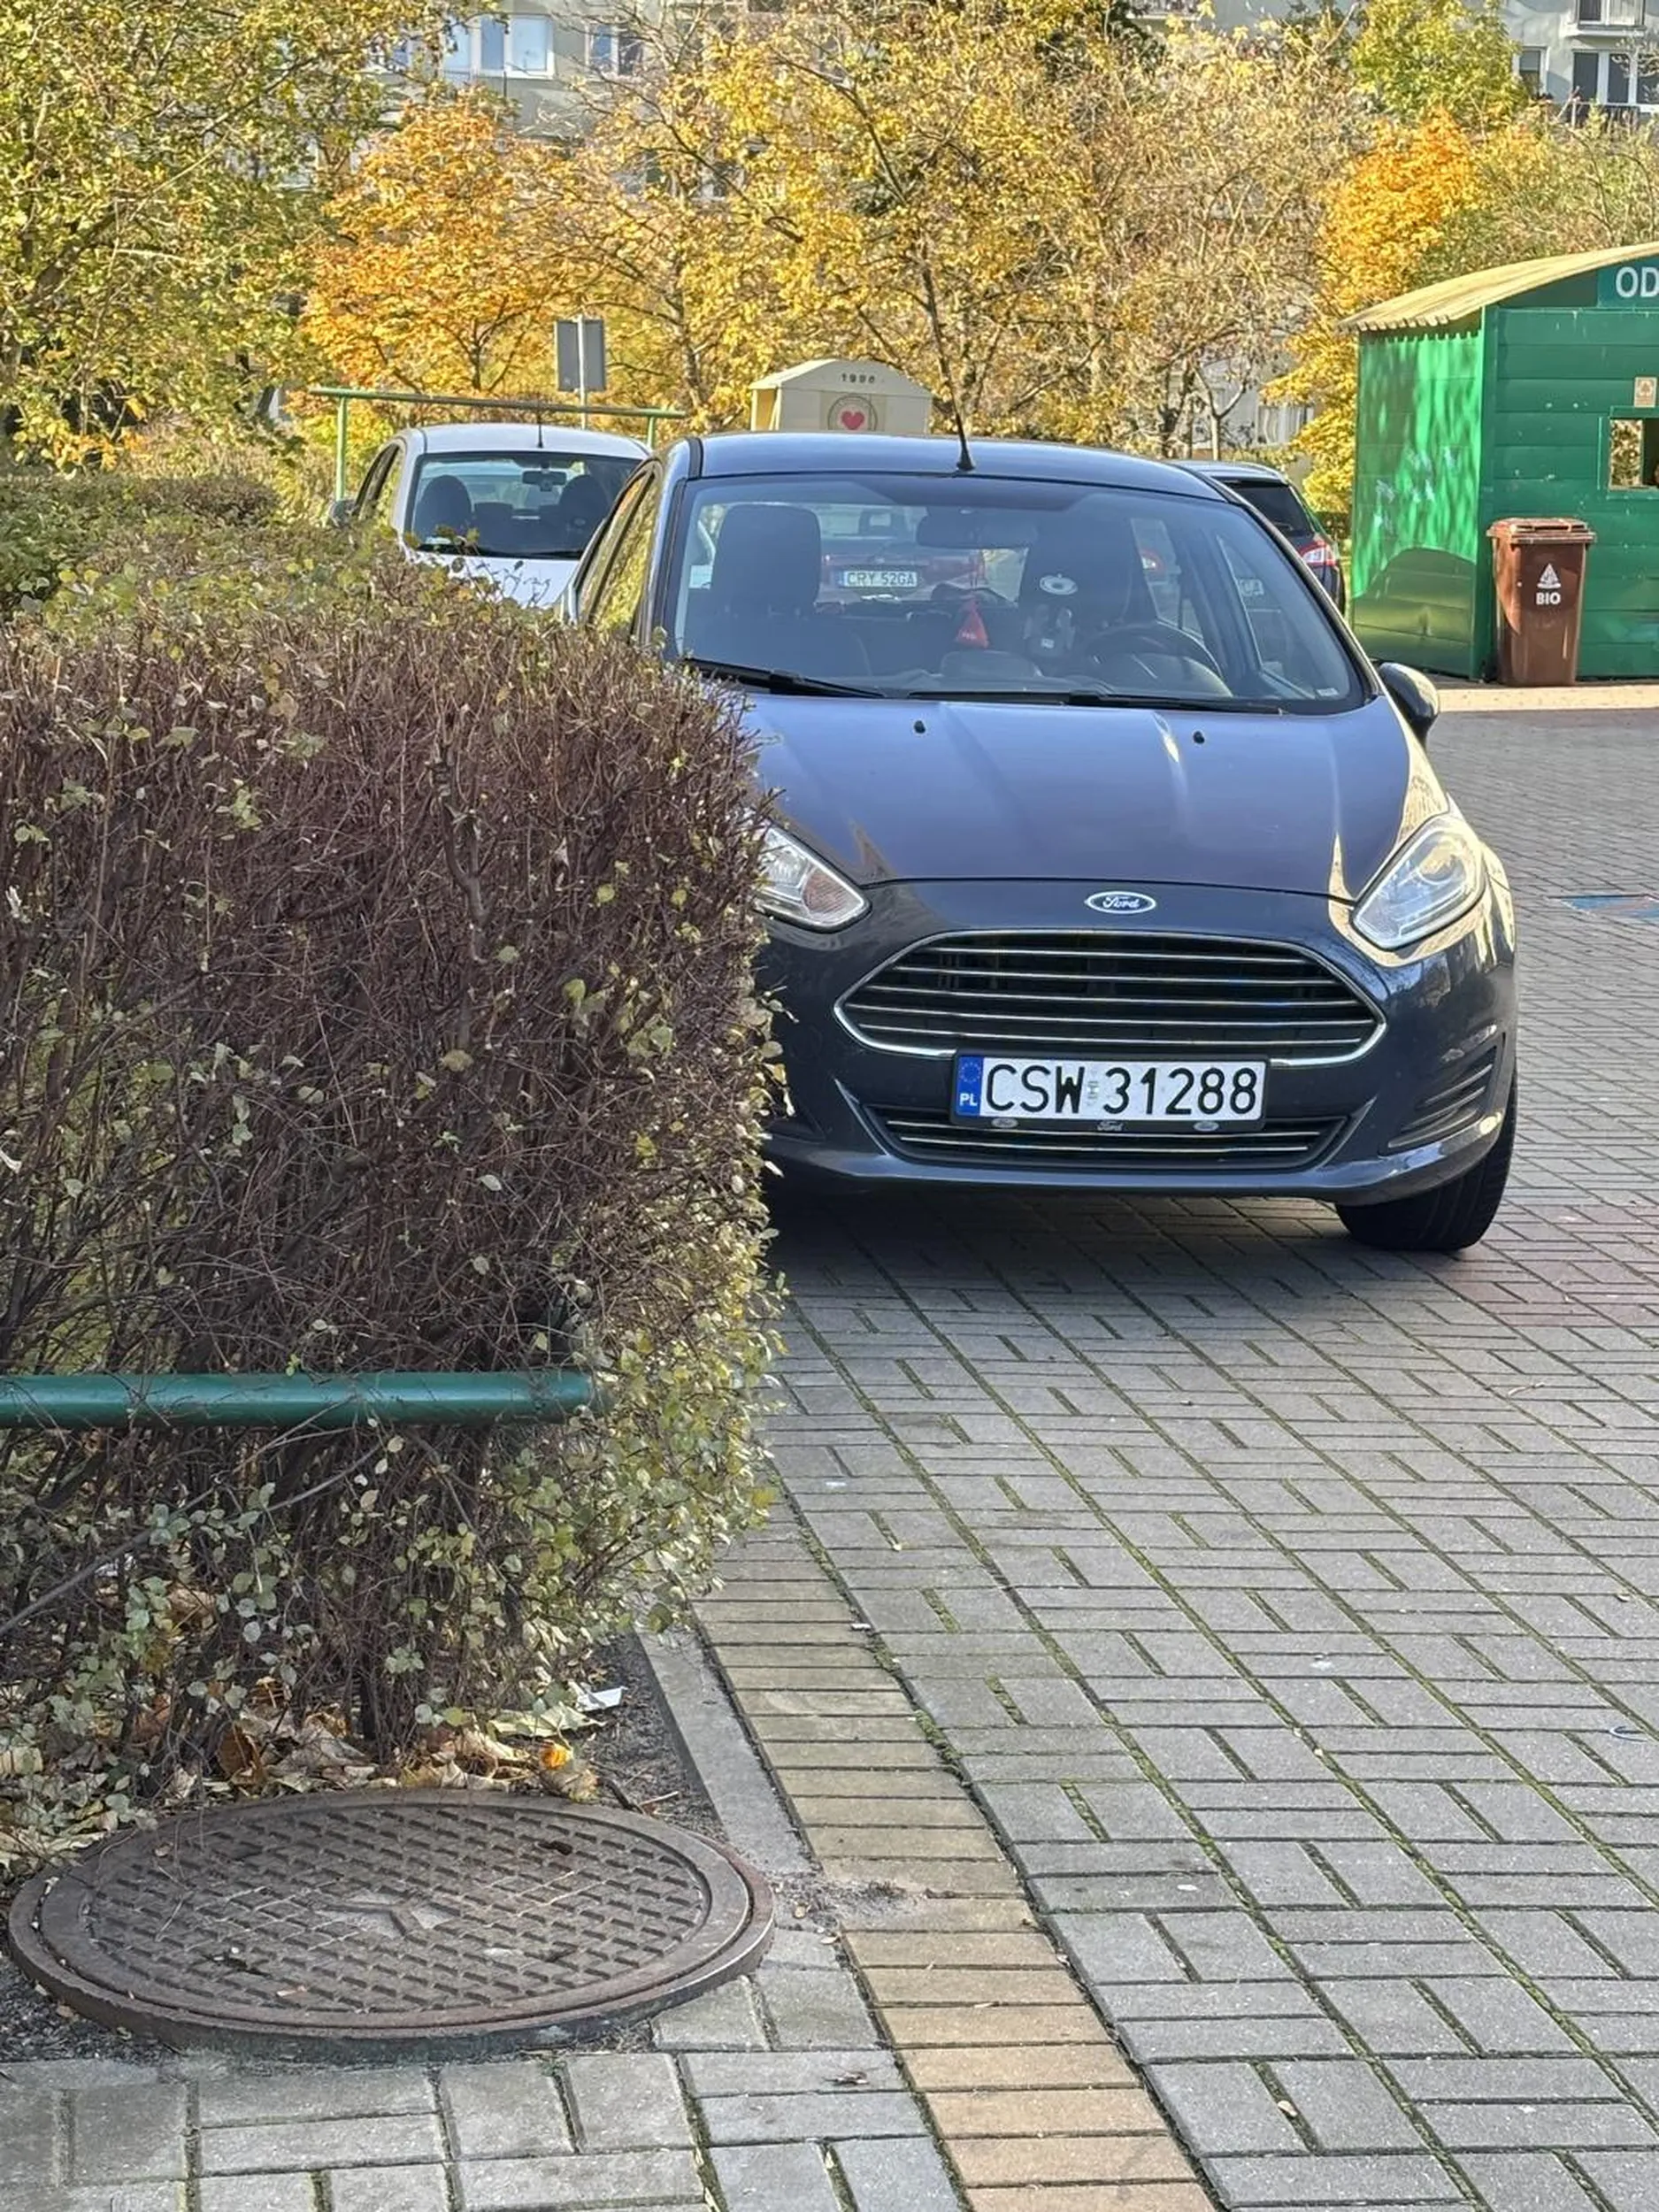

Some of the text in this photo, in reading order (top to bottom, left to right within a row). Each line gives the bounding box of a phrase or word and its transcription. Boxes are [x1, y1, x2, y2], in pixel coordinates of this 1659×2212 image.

[847, 572, 874, 585] CRY
[1536, 592, 1561, 605] BIO
[1102, 895, 1140, 909] Ford
[986, 1064, 1258, 1115] CSW 31288
[959, 1094, 978, 1107] PL
